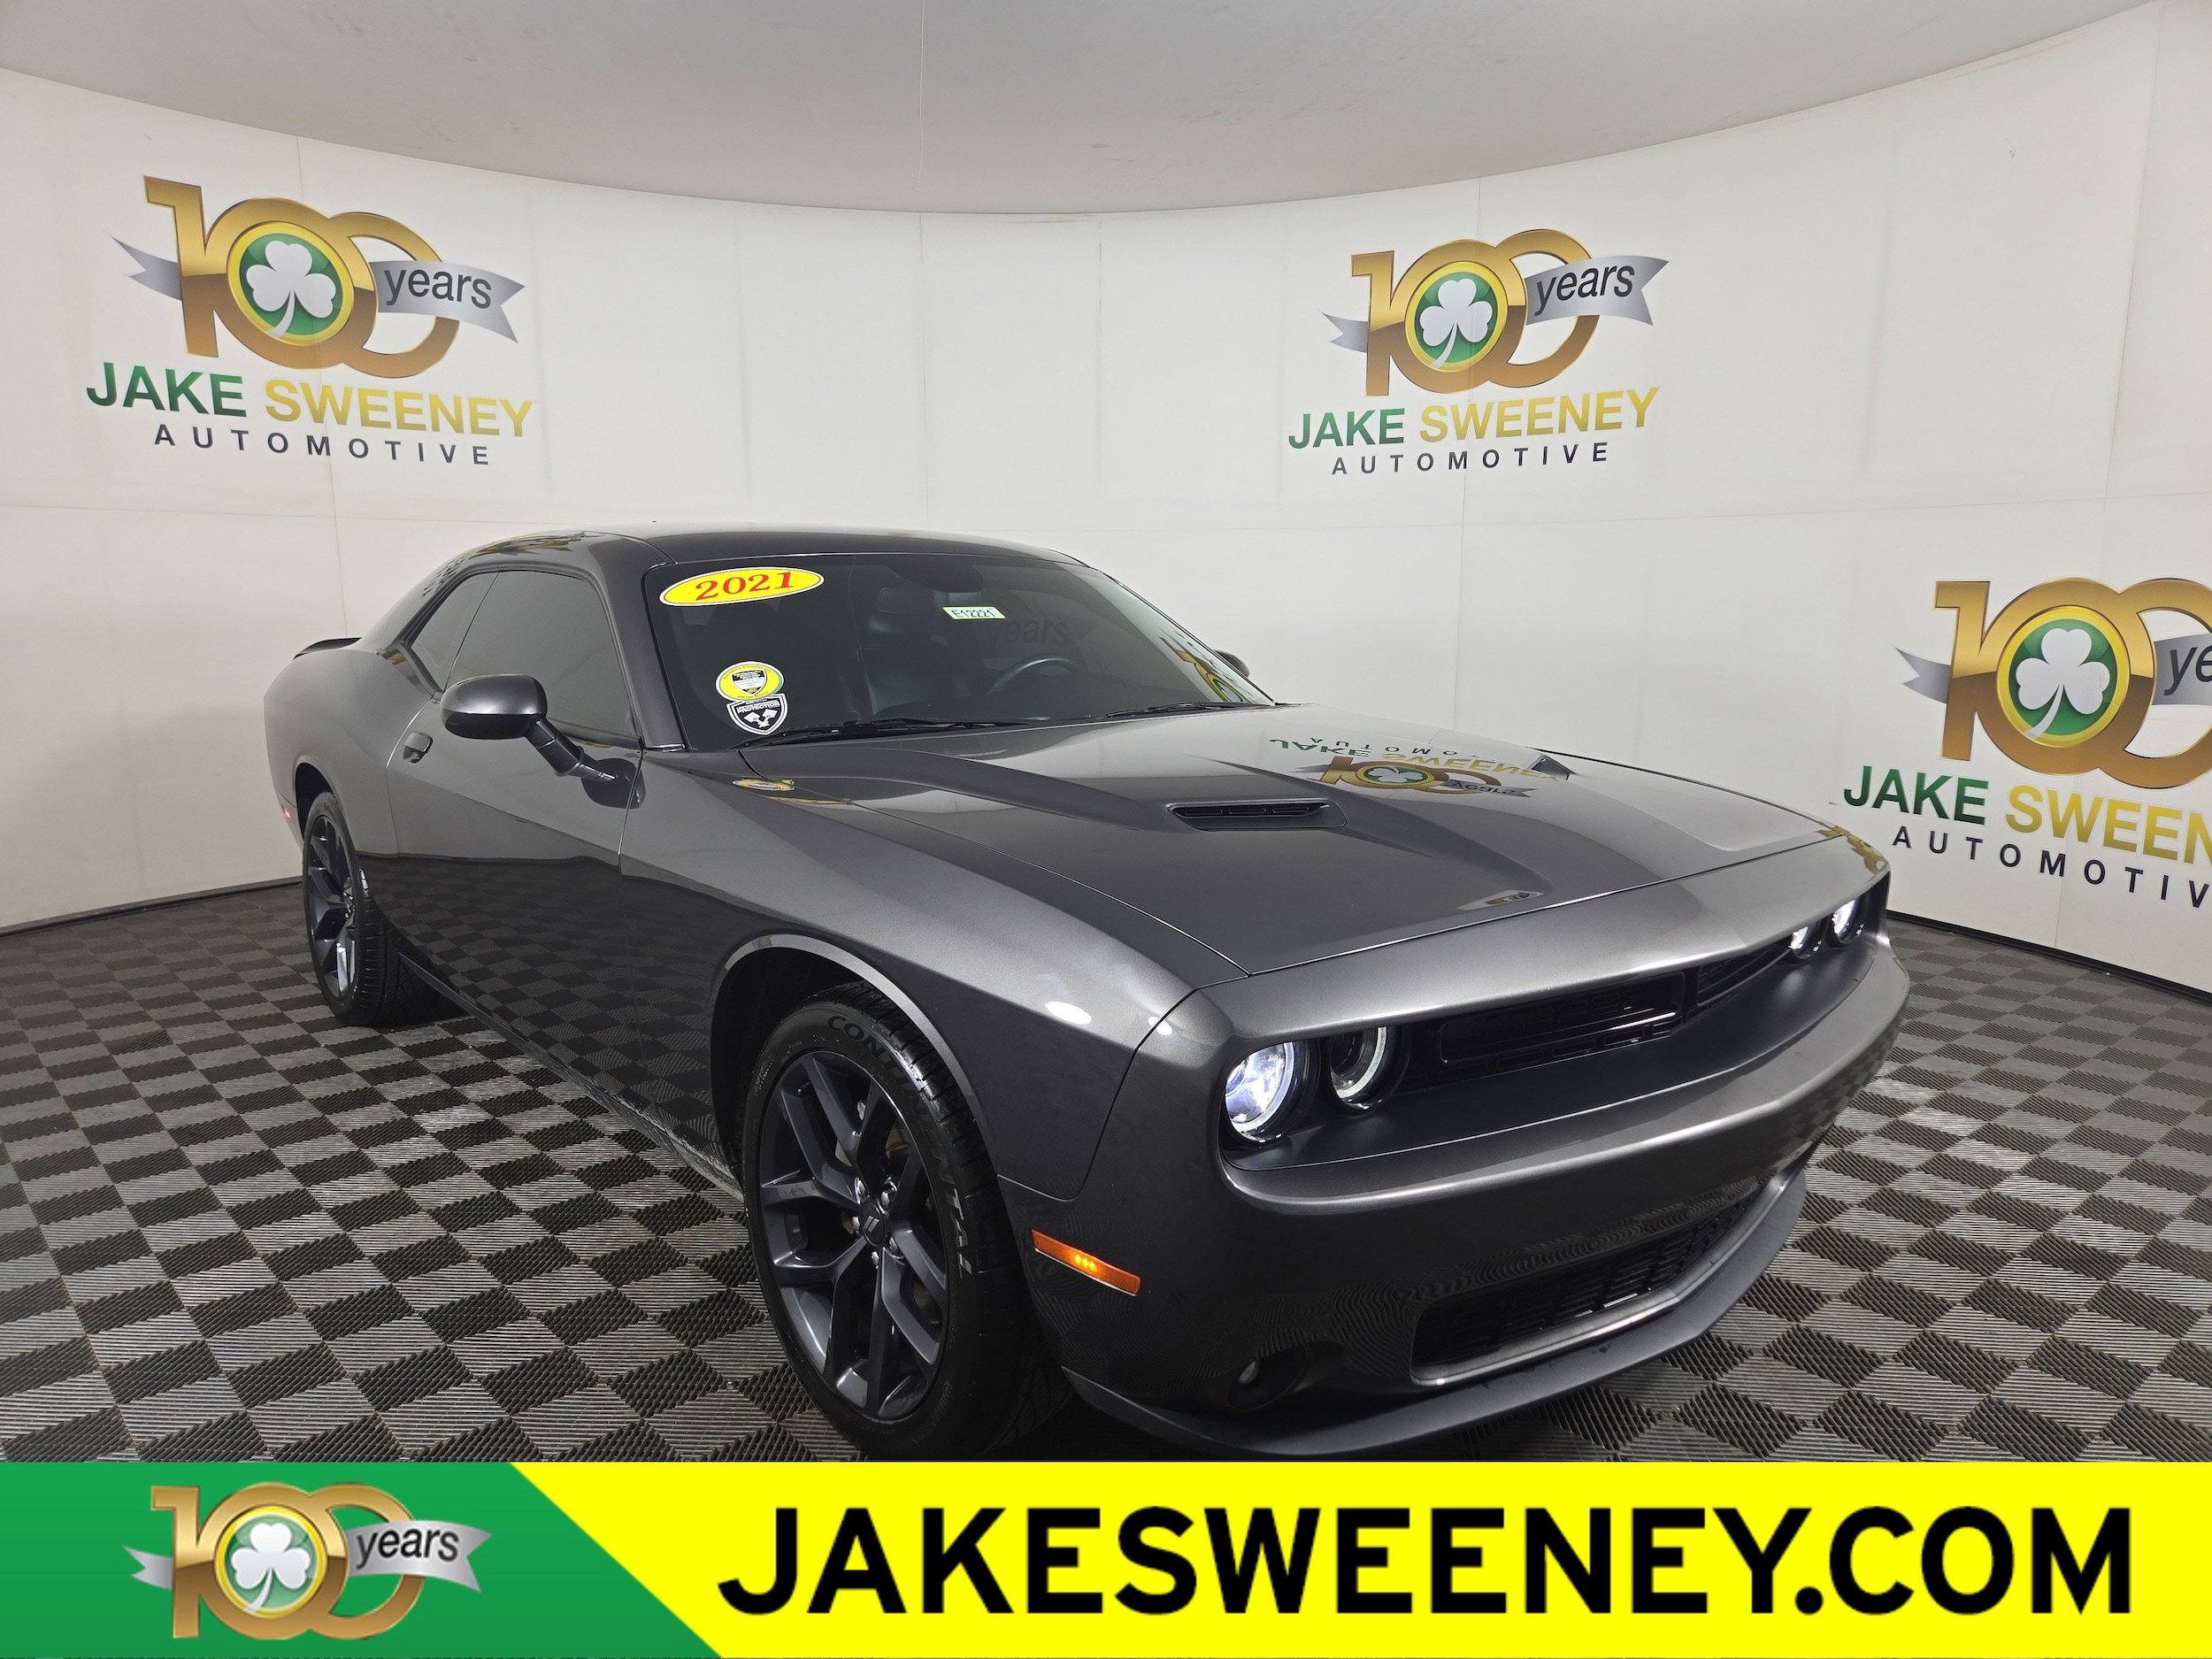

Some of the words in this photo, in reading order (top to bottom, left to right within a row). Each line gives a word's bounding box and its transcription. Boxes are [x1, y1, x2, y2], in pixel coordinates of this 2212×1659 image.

[143, 175, 460, 379] 100
[383, 265, 492, 311] years
[1351, 228, 1600, 396] 100
[1533, 264, 1635, 317] years
[86, 361, 247, 418] JAKE
[265, 379, 534, 437] SWEENEY
[1288, 408, 1405, 449] JAKE
[1419, 387, 1659, 442] SWEENEY
[155, 424, 489, 465] AUTOMOTIVE
[1332, 442, 1608, 475] AUTOMOTIVE
[695, 572, 795, 601] 2021
[1843, 765, 1989, 826] JAKE
[2005, 785, 2212, 866] SWEEN
[1892, 826, 2209, 909] AUTOMOTIV
